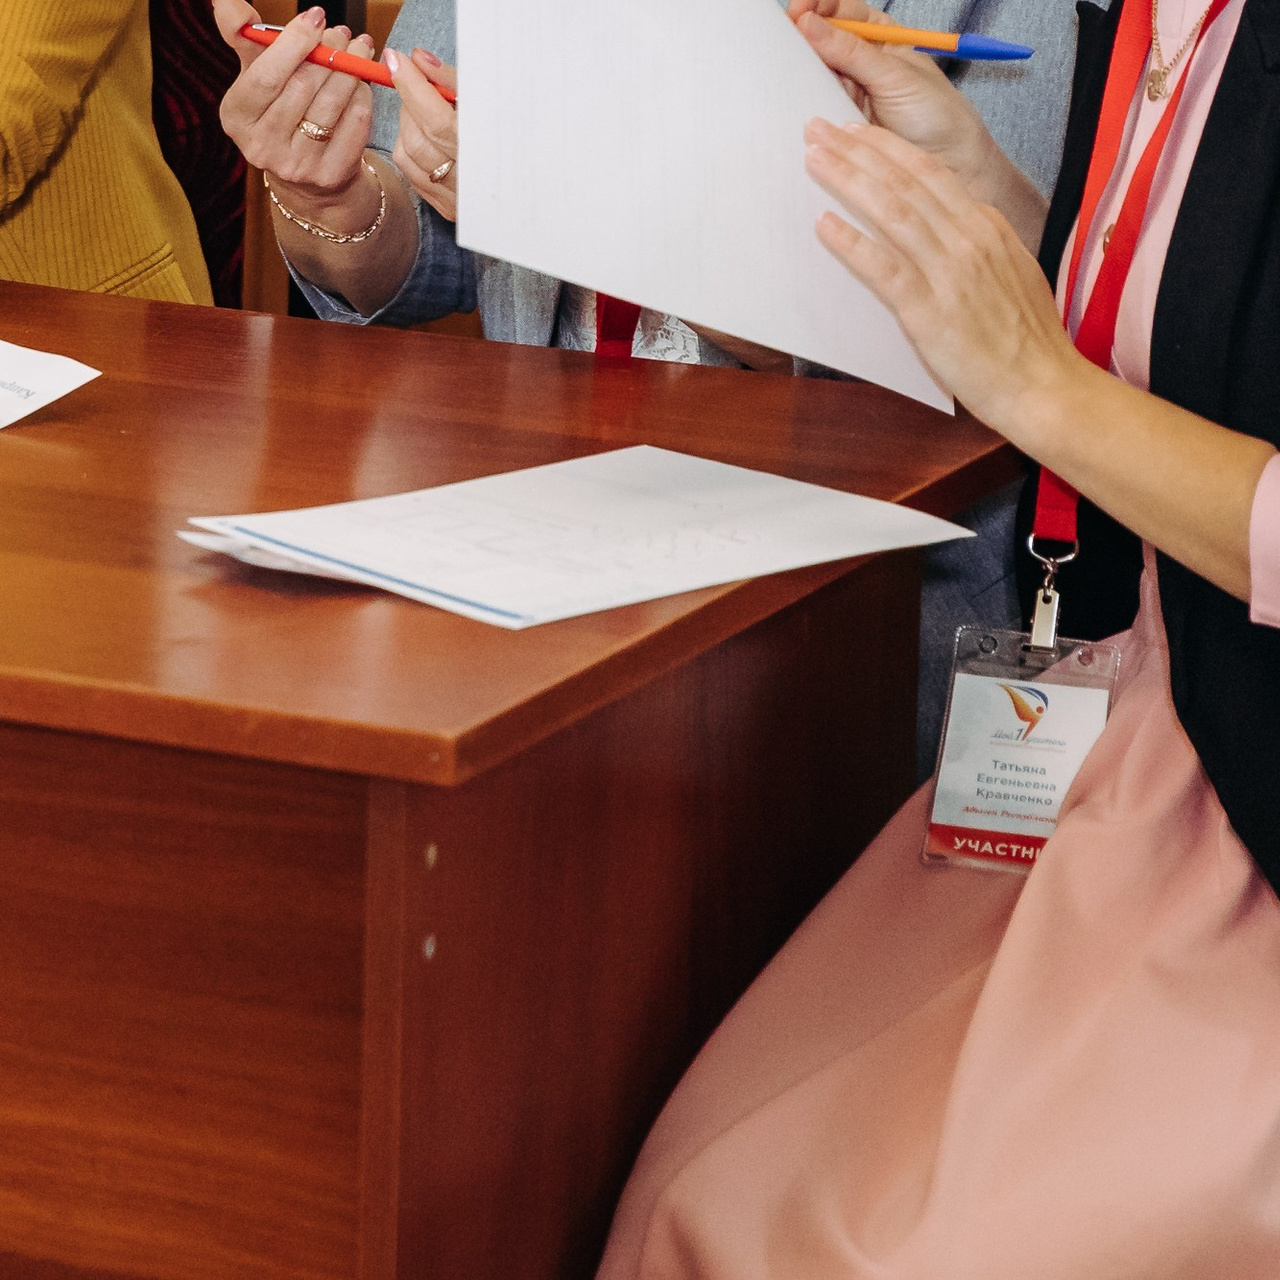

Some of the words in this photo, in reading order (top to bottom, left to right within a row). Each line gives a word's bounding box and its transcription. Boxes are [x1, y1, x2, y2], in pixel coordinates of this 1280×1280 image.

[1015, 727, 1025, 741] 1
[992, 759, 1047, 776] Татьяна
[976, 773, 1057, 792] Евгеньевна
[976, 788, 1053, 806] Кравченко
